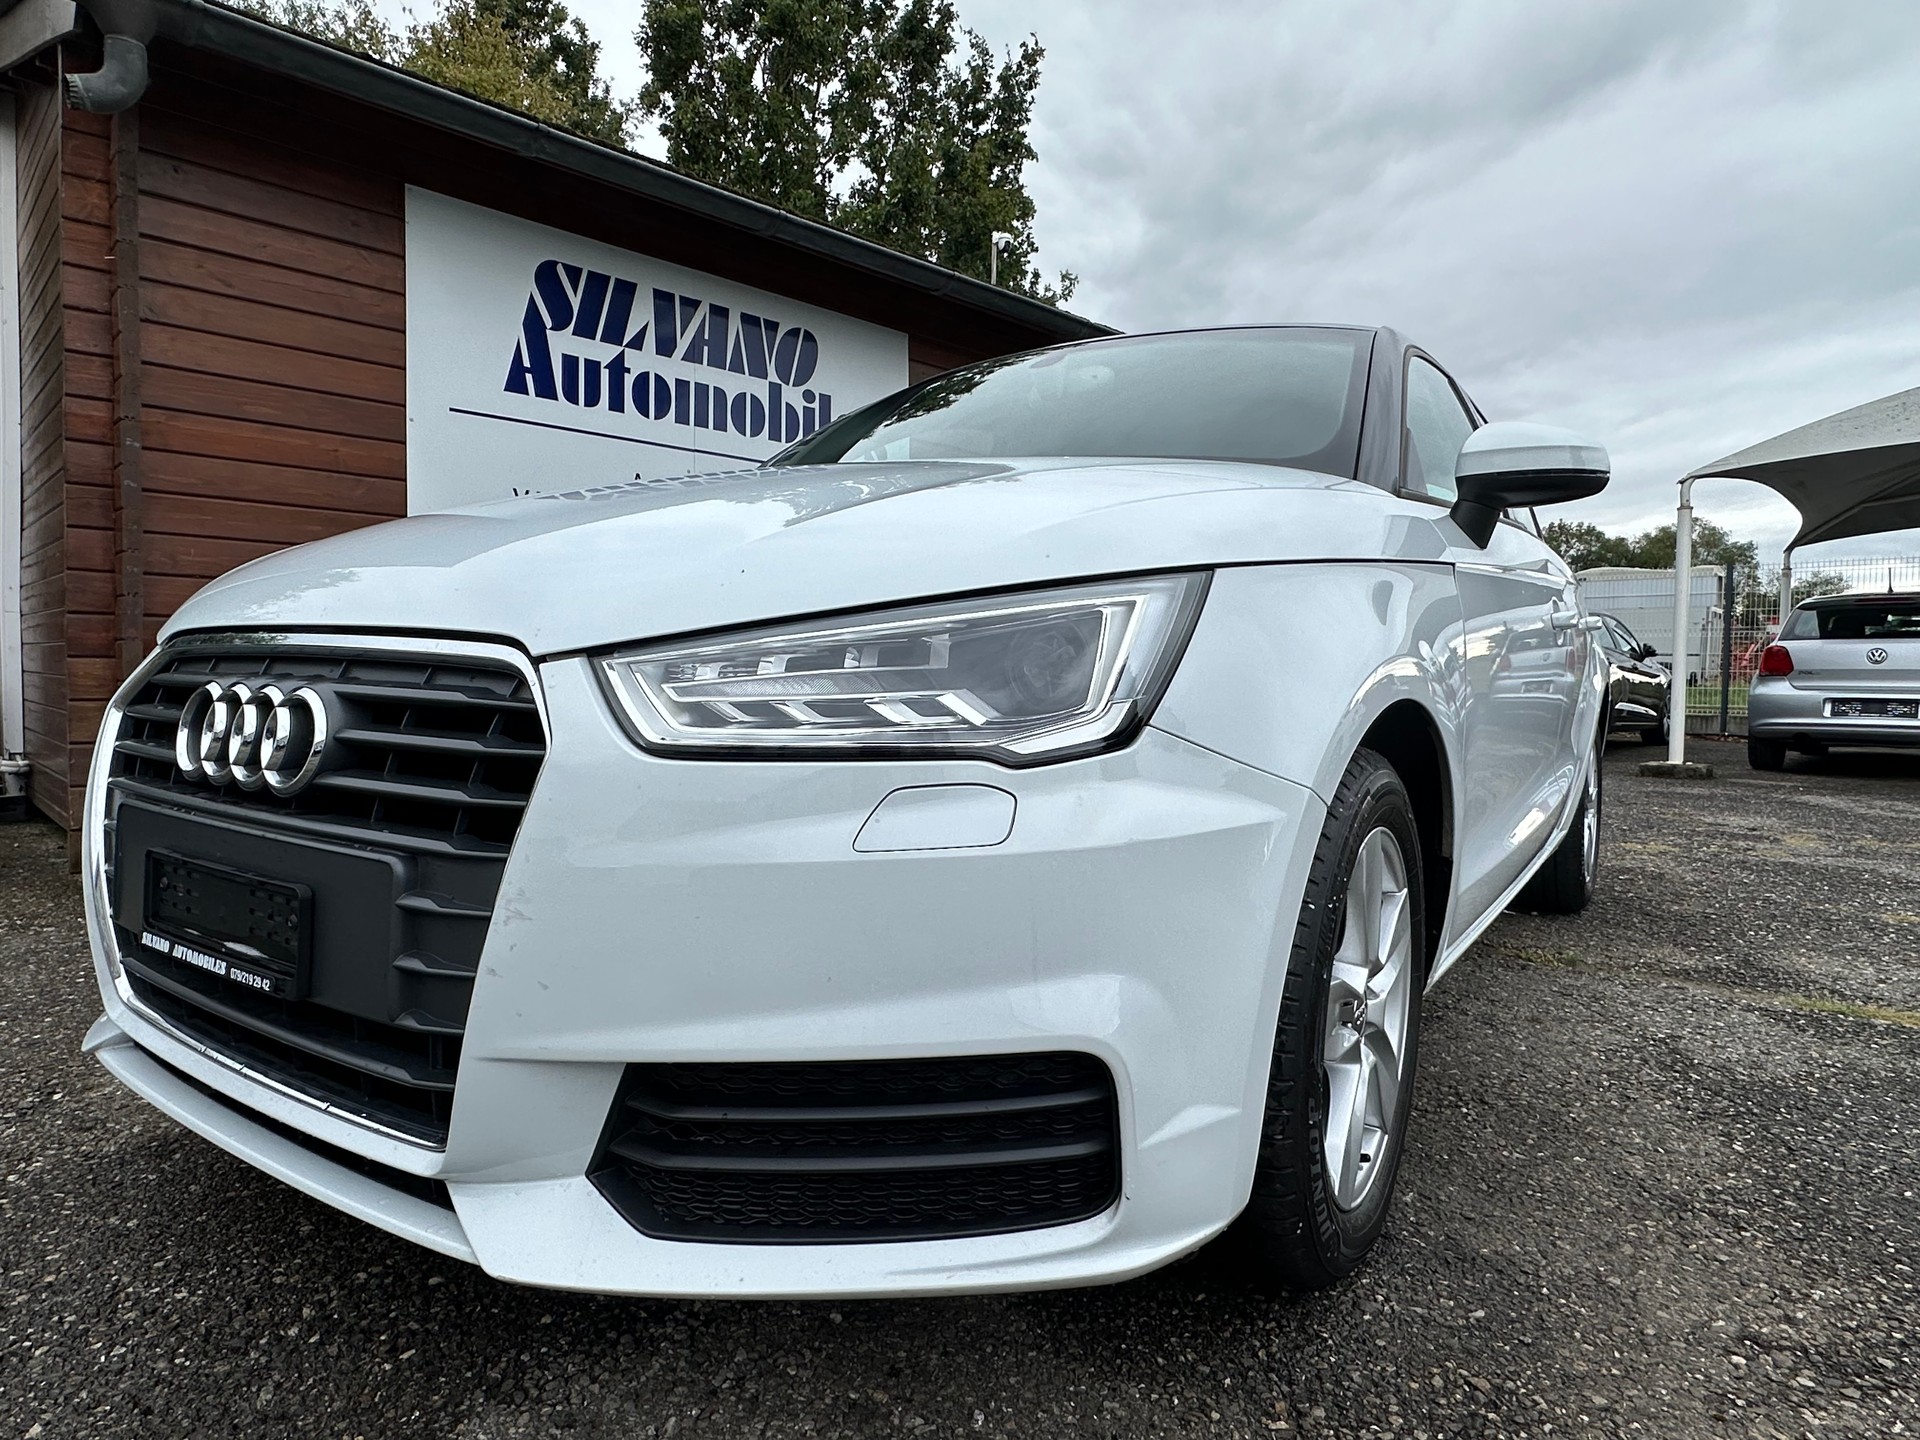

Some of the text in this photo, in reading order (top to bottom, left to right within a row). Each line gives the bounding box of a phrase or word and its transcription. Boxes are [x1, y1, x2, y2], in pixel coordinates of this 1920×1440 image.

[534, 259, 819, 388] SILVANO
[141, 931, 170, 953] SILVANO
[172, 944, 227, 975] AUTOMOBILES
[230, 967, 253, 985] 079/219
[262, 979, 270, 991] 42
[1308, 1097, 1334, 1243] DUNLOP
